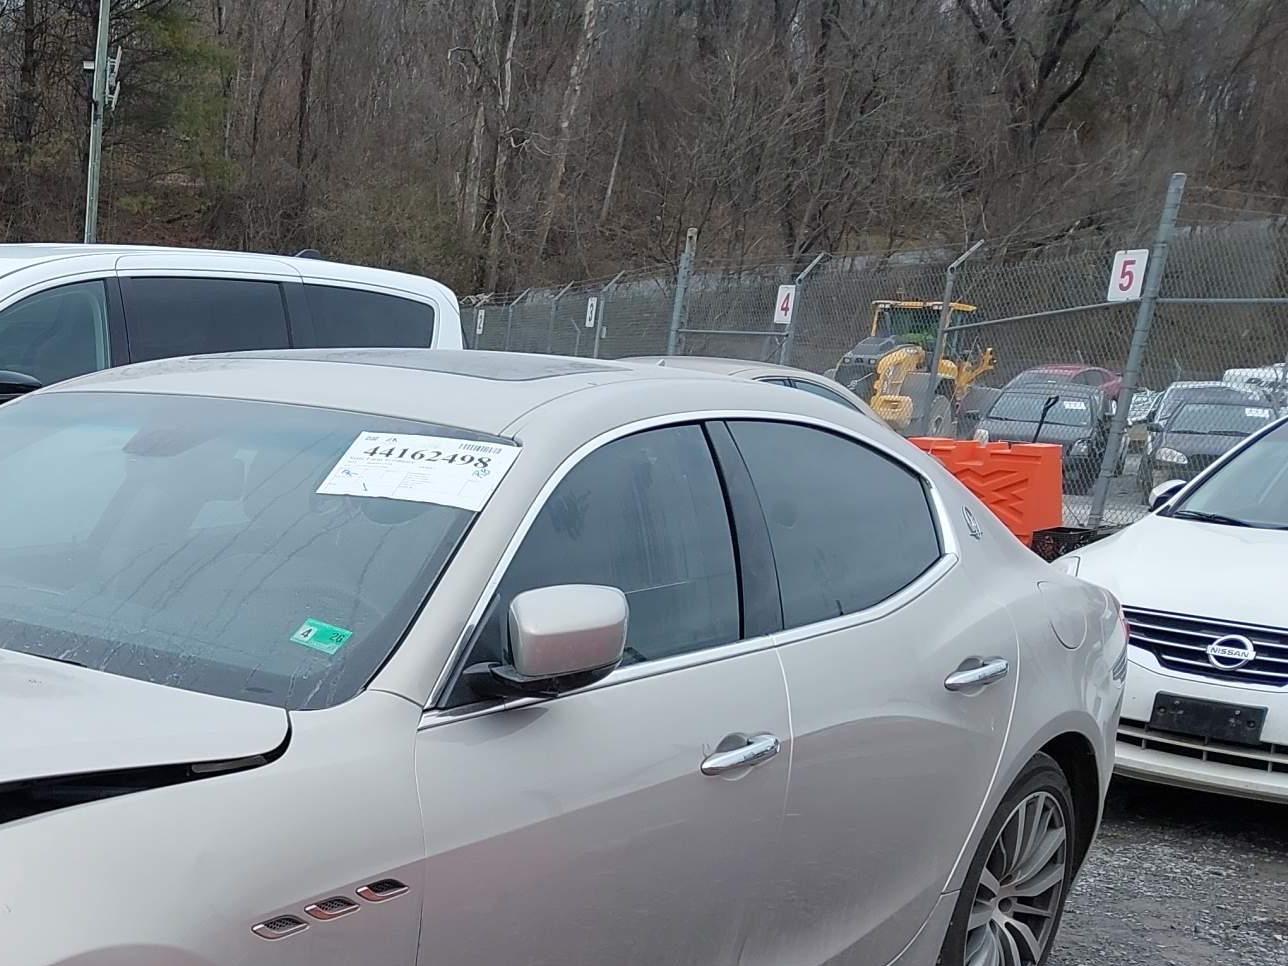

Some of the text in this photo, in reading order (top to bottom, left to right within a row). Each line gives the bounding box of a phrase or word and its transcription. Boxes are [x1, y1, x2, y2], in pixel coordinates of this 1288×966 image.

[1118, 259, 1137, 291] 5
[780, 292, 790, 317] 4
[363, 446, 492, 469] 44162498
[300, 628, 313, 638] 4
[1211, 647, 1249, 658] NISSAN
